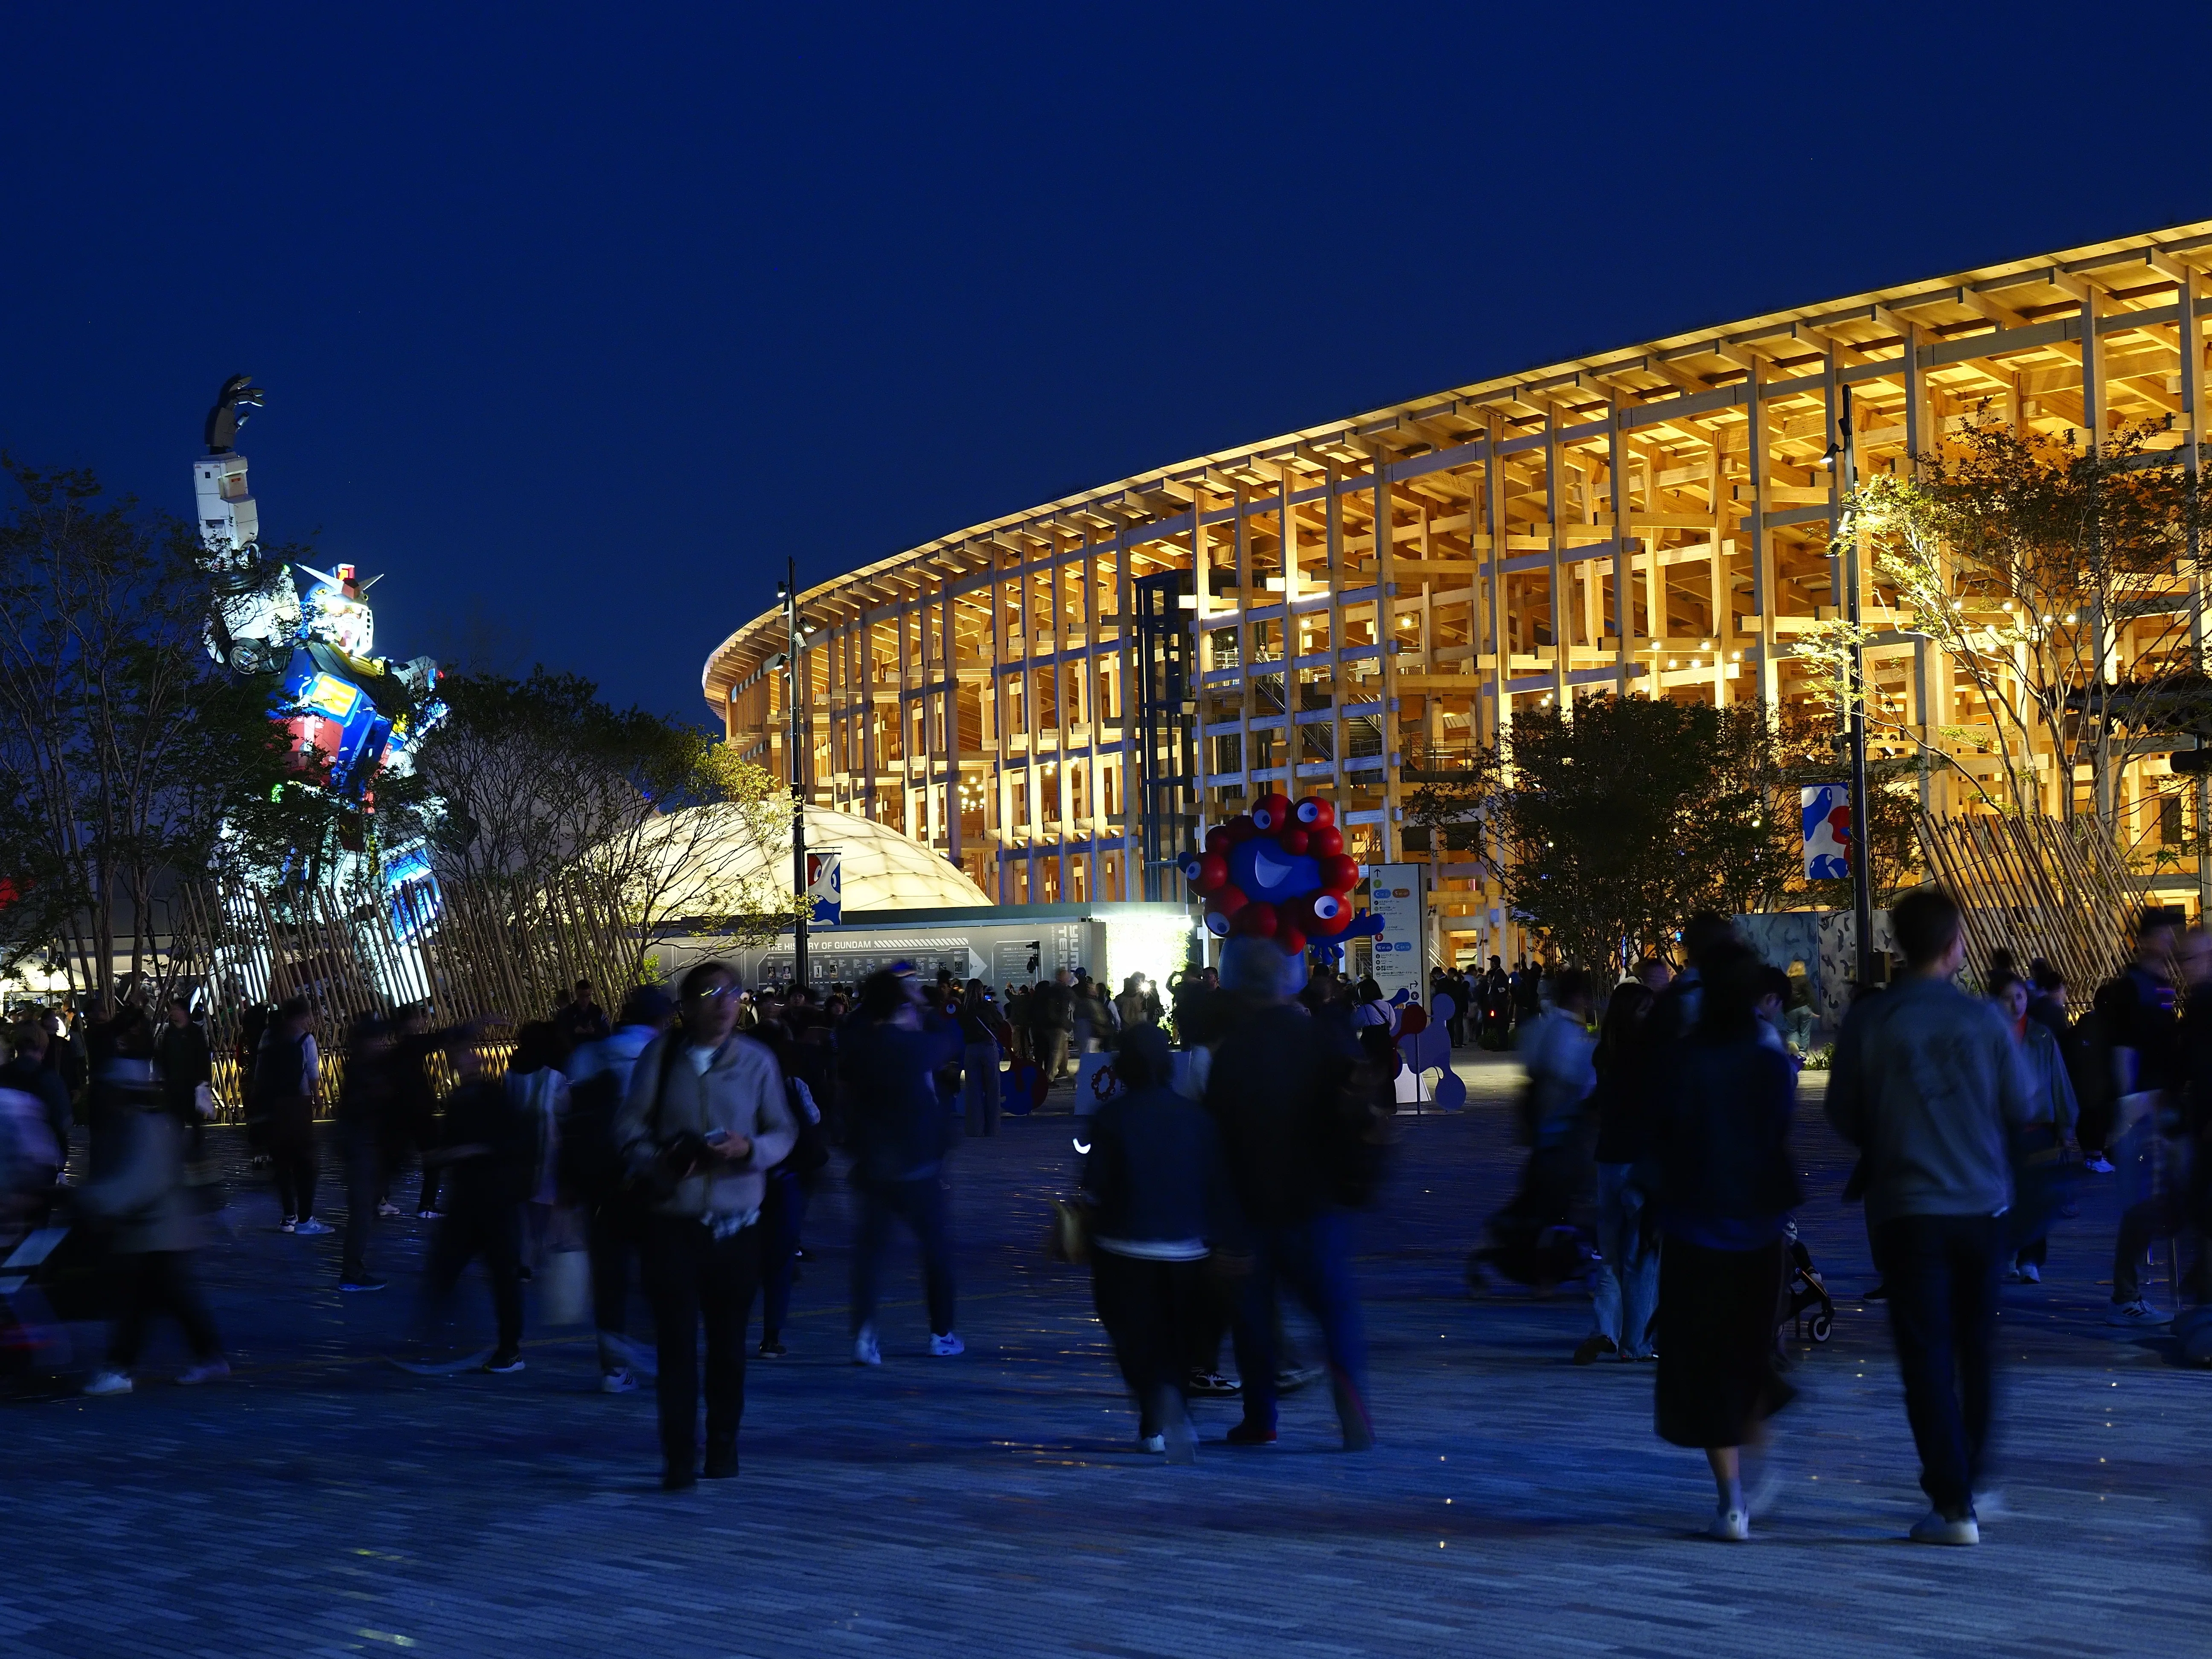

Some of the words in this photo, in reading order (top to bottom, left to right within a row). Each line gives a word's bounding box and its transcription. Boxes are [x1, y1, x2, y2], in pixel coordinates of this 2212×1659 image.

[784, 942, 819, 951] HISRY
[834, 941, 871, 949] GUNDAM
[1069, 925, 1079, 971] YUM
